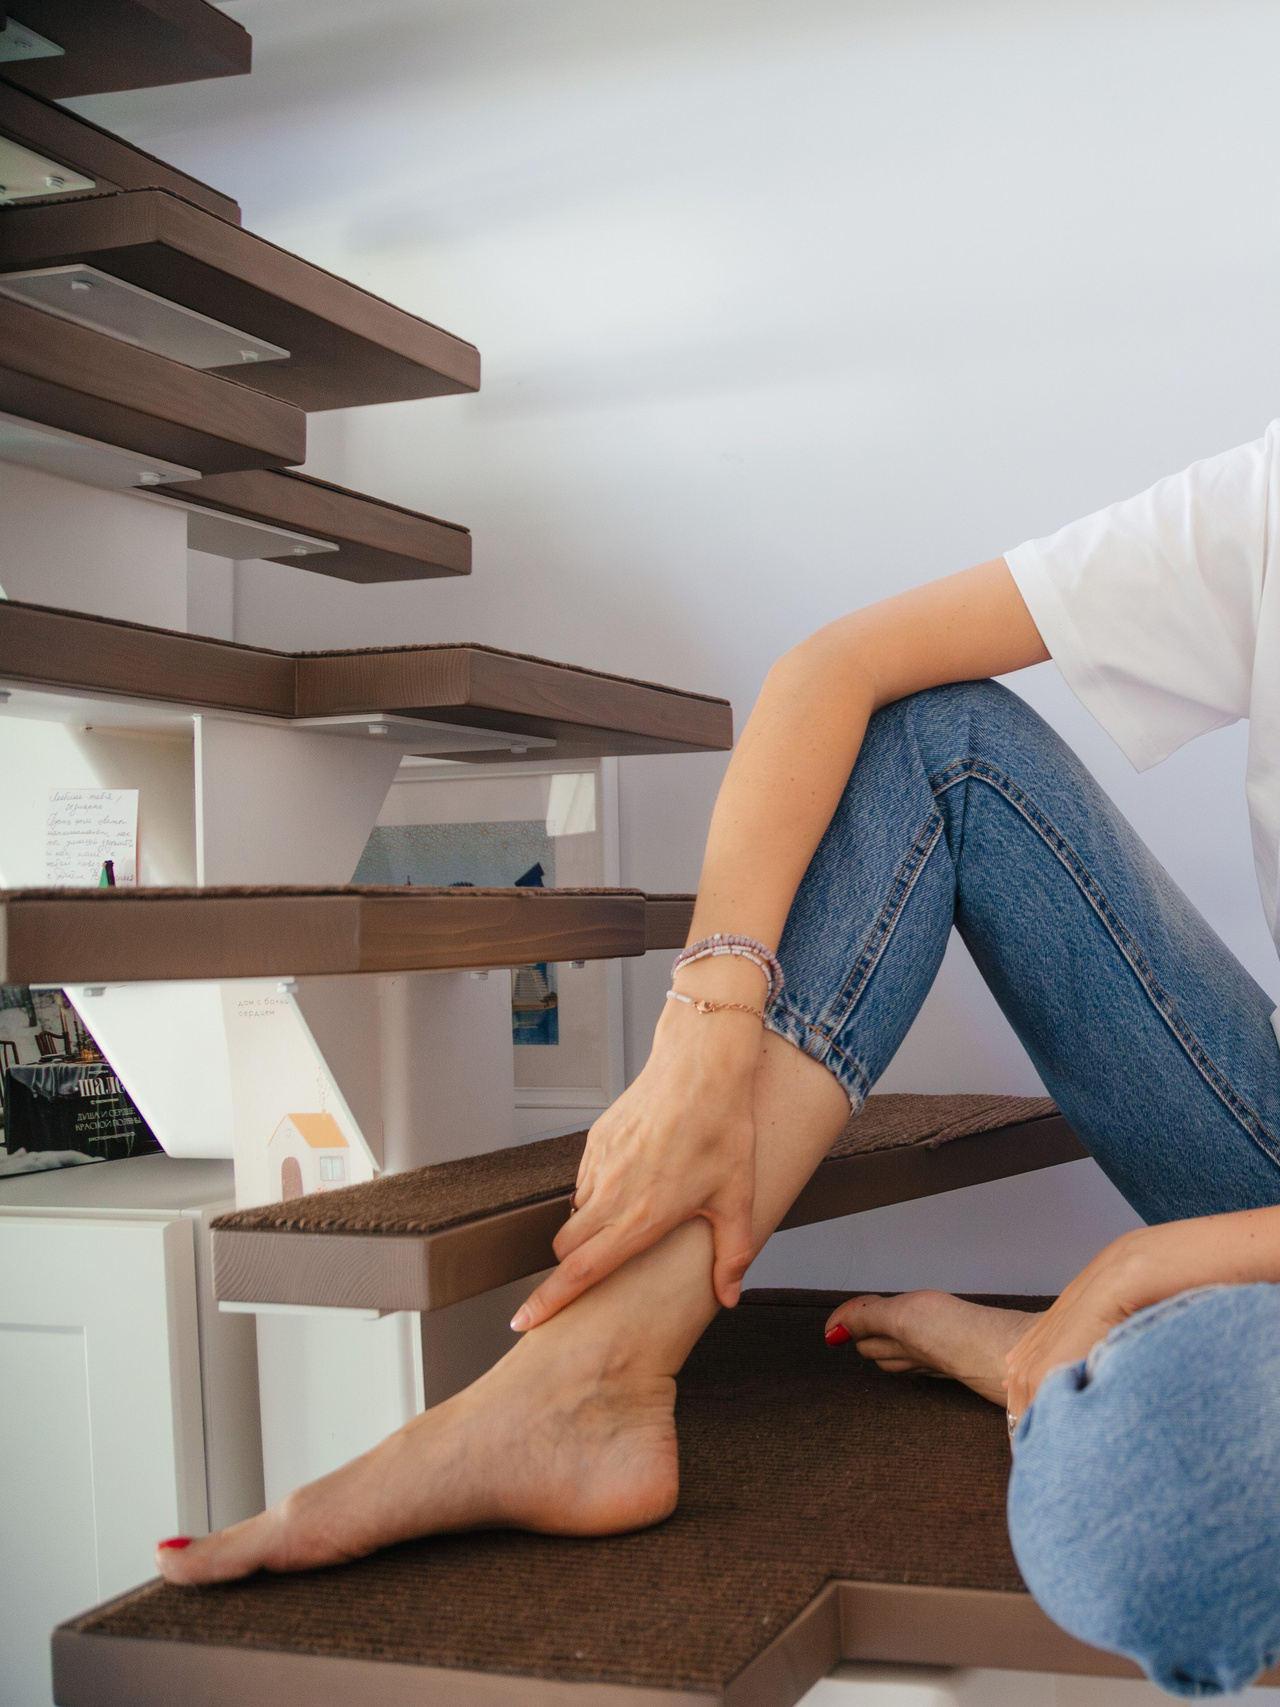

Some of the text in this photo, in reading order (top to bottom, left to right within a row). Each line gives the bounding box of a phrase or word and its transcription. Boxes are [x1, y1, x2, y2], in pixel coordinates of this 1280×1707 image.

[239, 1010, 275, 1018] сердцем
[77, 1111, 100, 1122] ДУША
[108, 1107, 136, 1117] СЕРДЦЕ
[75, 1116, 142, 1131] КРАСНОЙ ПОЛЯНЫ
